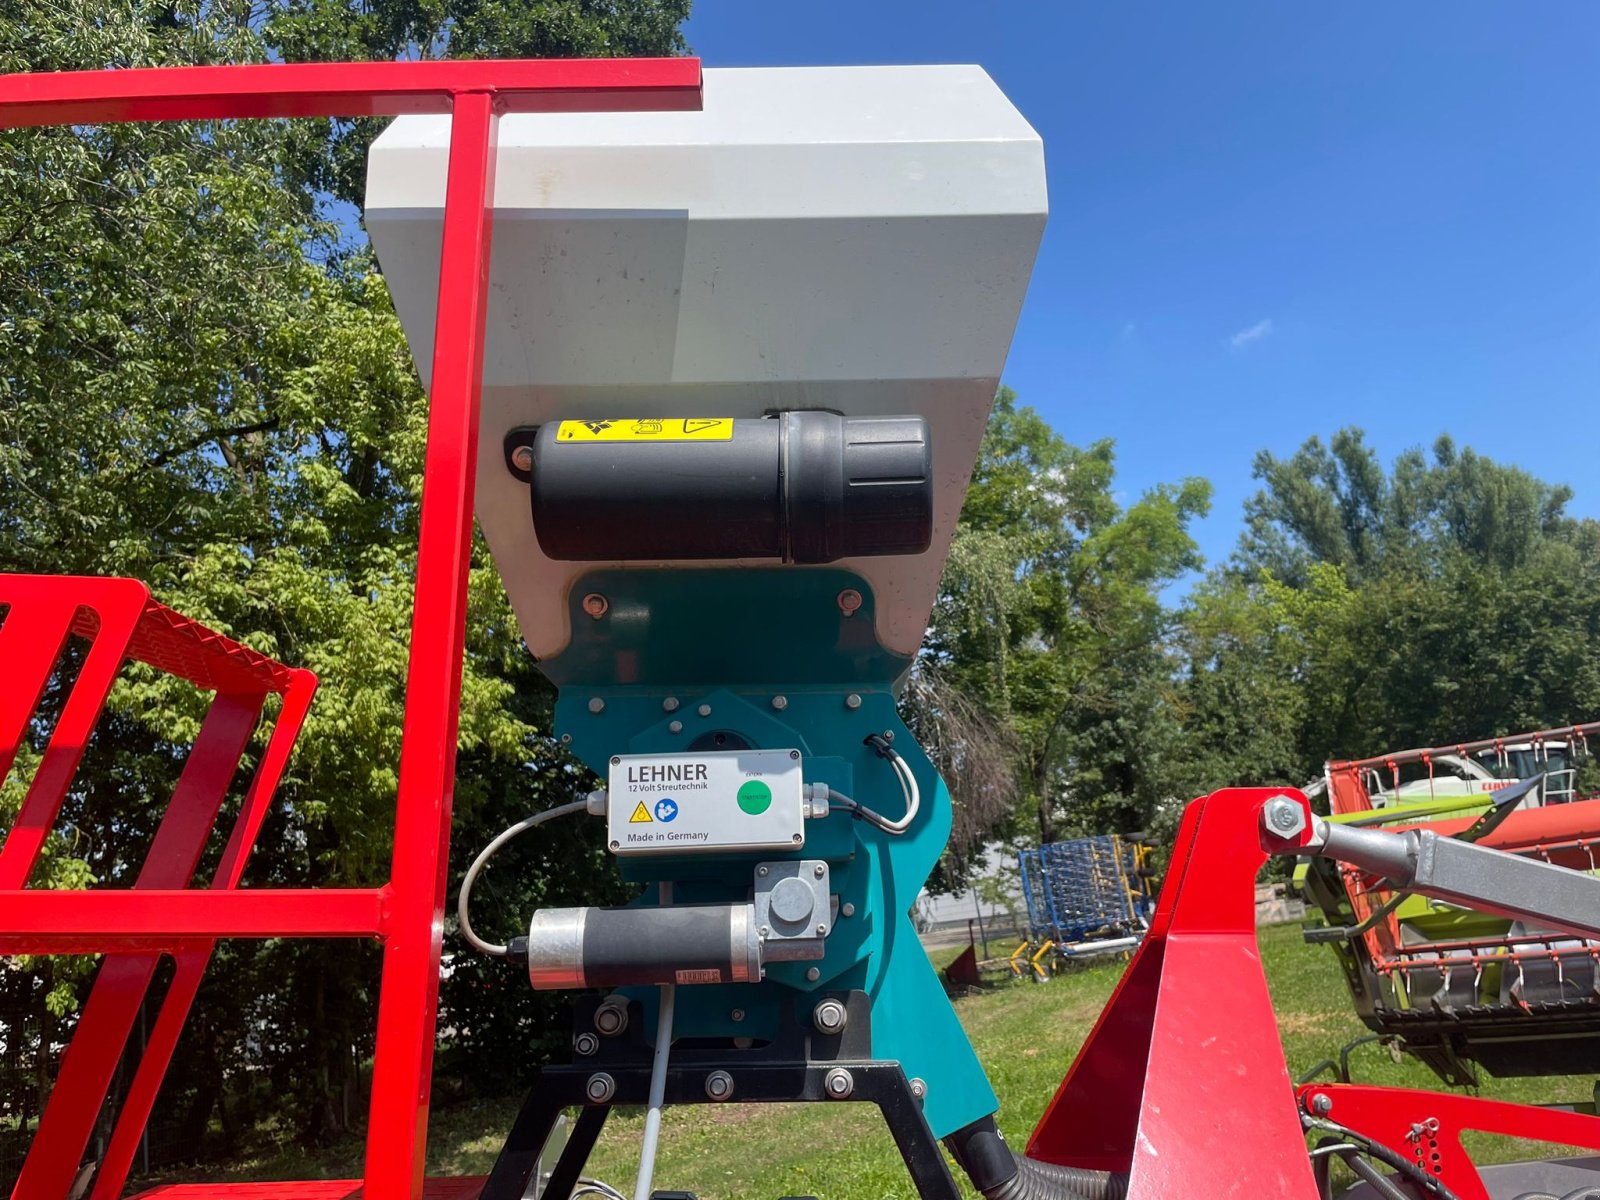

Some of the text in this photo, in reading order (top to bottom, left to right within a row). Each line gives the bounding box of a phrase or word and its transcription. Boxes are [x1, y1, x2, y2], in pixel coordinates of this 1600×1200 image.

[628, 764, 708, 782] LEHNER
[639, 784, 656, 792] Volt
[657, 782, 708, 791] Streutechnik
[627, 832, 709, 842] Made in Germany
